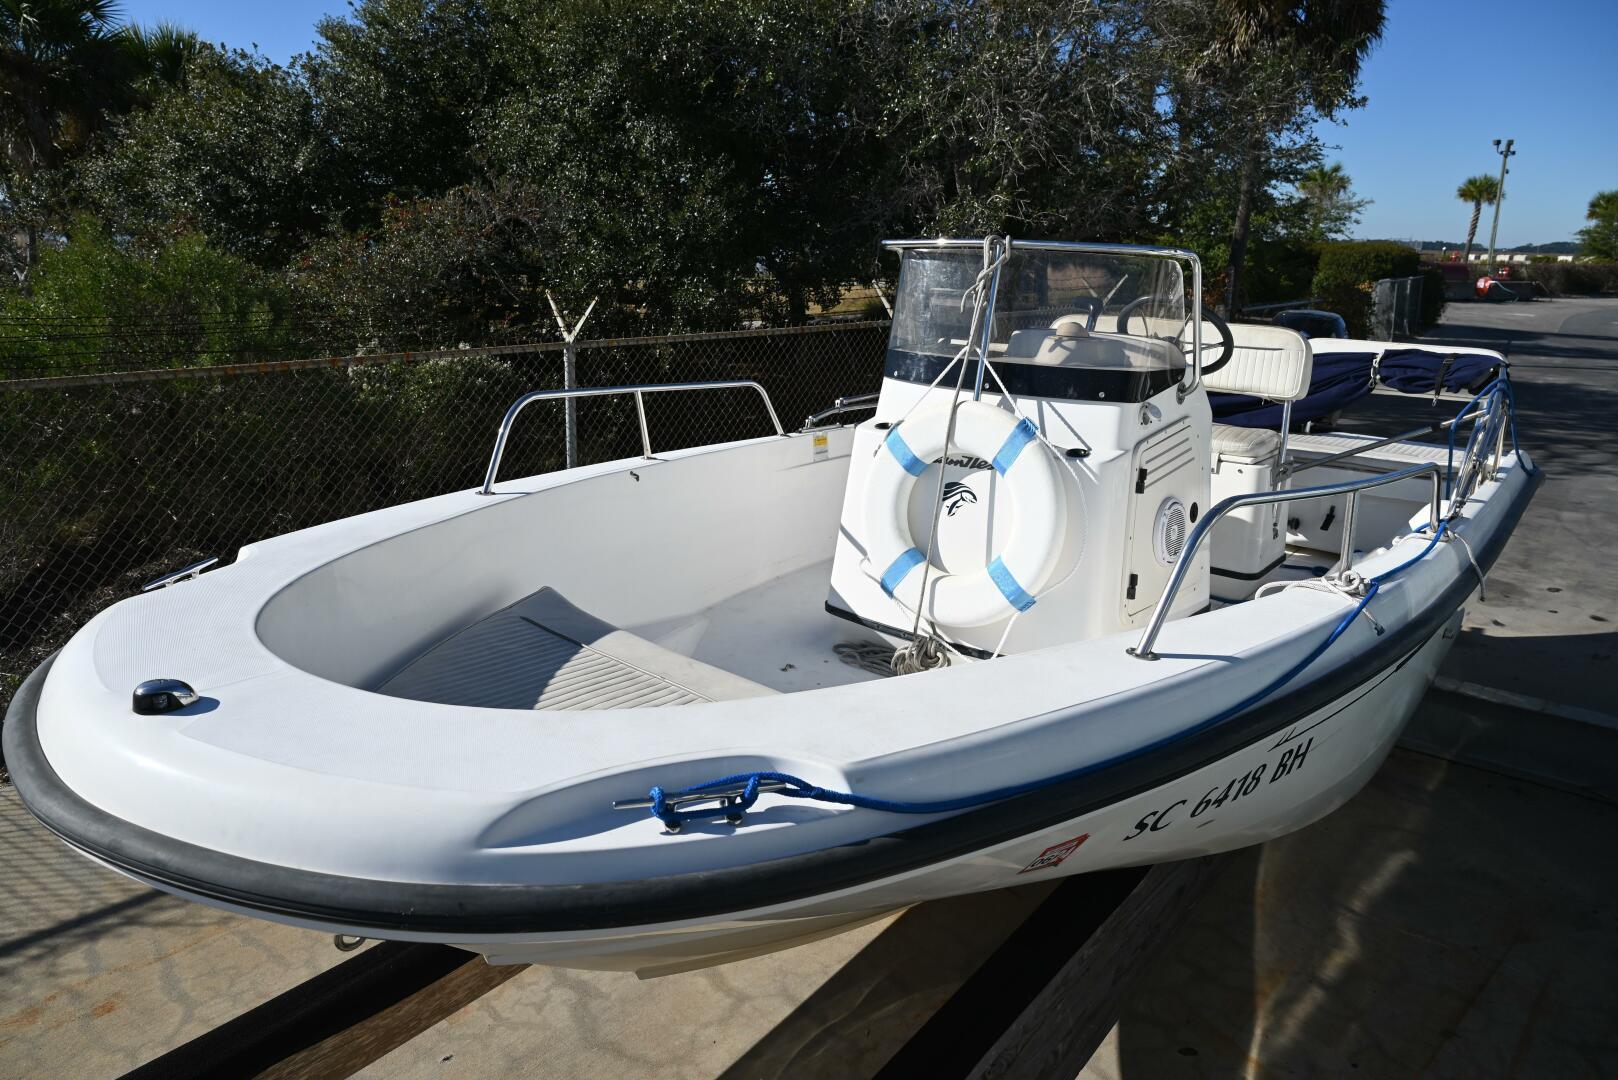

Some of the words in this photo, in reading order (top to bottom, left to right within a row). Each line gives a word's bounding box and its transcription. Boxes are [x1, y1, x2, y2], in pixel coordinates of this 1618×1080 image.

[1122, 799, 1188, 842] SC
[1190, 763, 1268, 818] 6418
[1269, 736, 1315, 785] BH
